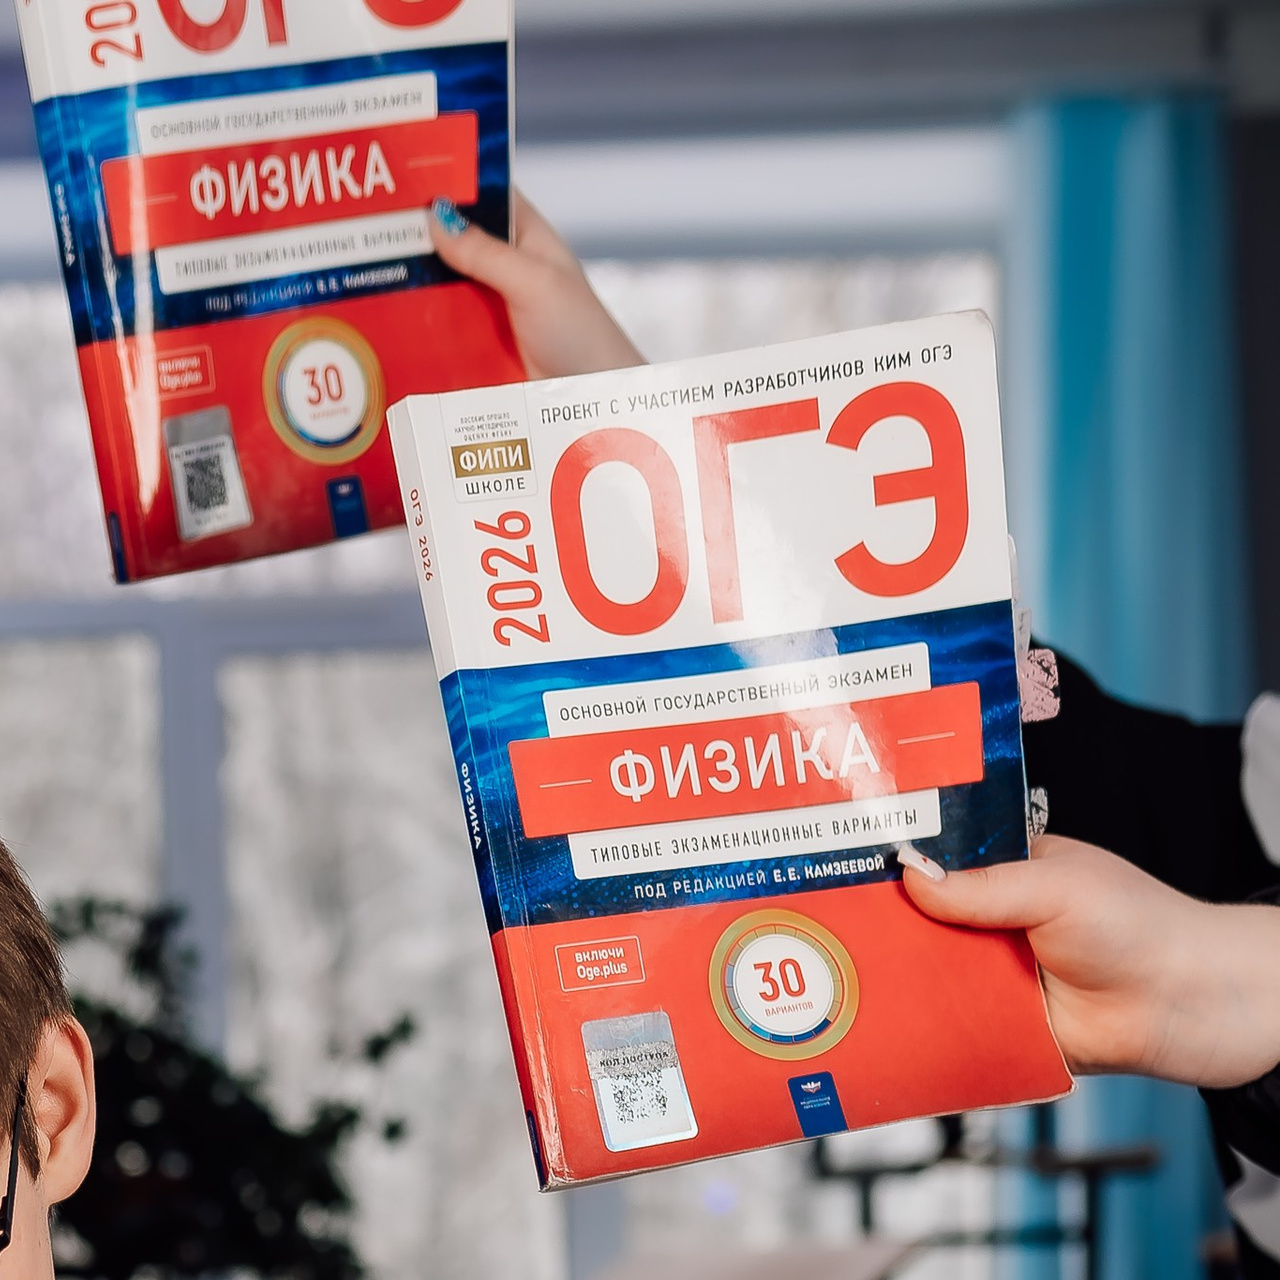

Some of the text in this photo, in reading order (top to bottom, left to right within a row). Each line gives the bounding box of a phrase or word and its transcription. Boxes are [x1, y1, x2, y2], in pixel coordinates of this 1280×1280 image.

[85, 0, 144, 68] 20
[189, 141, 396, 220] ФИЗИКА
[303, 364, 343, 405] 30
[541, 344, 953, 424] ПРОЕКТ С УЧАСТИЕМ РАЗРАБОТЧИКОВ КИМ ОГЭ
[459, 444, 524, 472] ФИПИ
[465, 476, 526, 495] ШКОЛЕ
[410, 488, 434, 582] ОГЭ 2026
[550, 381, 969, 636] ОГЭ
[474, 510, 550, 648] 2026
[559, 663, 914, 721] ОСНОВНОЙ ГОСУДАРСТВЕННЫЙ ЭКЗАМЕН
[609, 721, 880, 804] ФИЗИКА
[461, 762, 482, 850] ФИЗИКА
[591, 811, 918, 865] ТИПОВЫЕ ЭКЗАМЕНАЦИОННЫЕ ВАРИАНТЫ
[634, 882, 667, 900] ПОД
[673, 869, 767, 896] РЕДАКЦИЕЙ
[805, 853, 885, 880] КАМЗЕЕВОЙ
[576, 961, 628, 981] Oge.plus
[753, 957, 807, 1003] 30
[764, 1001, 814, 1018] ВАРИАНТОВ
